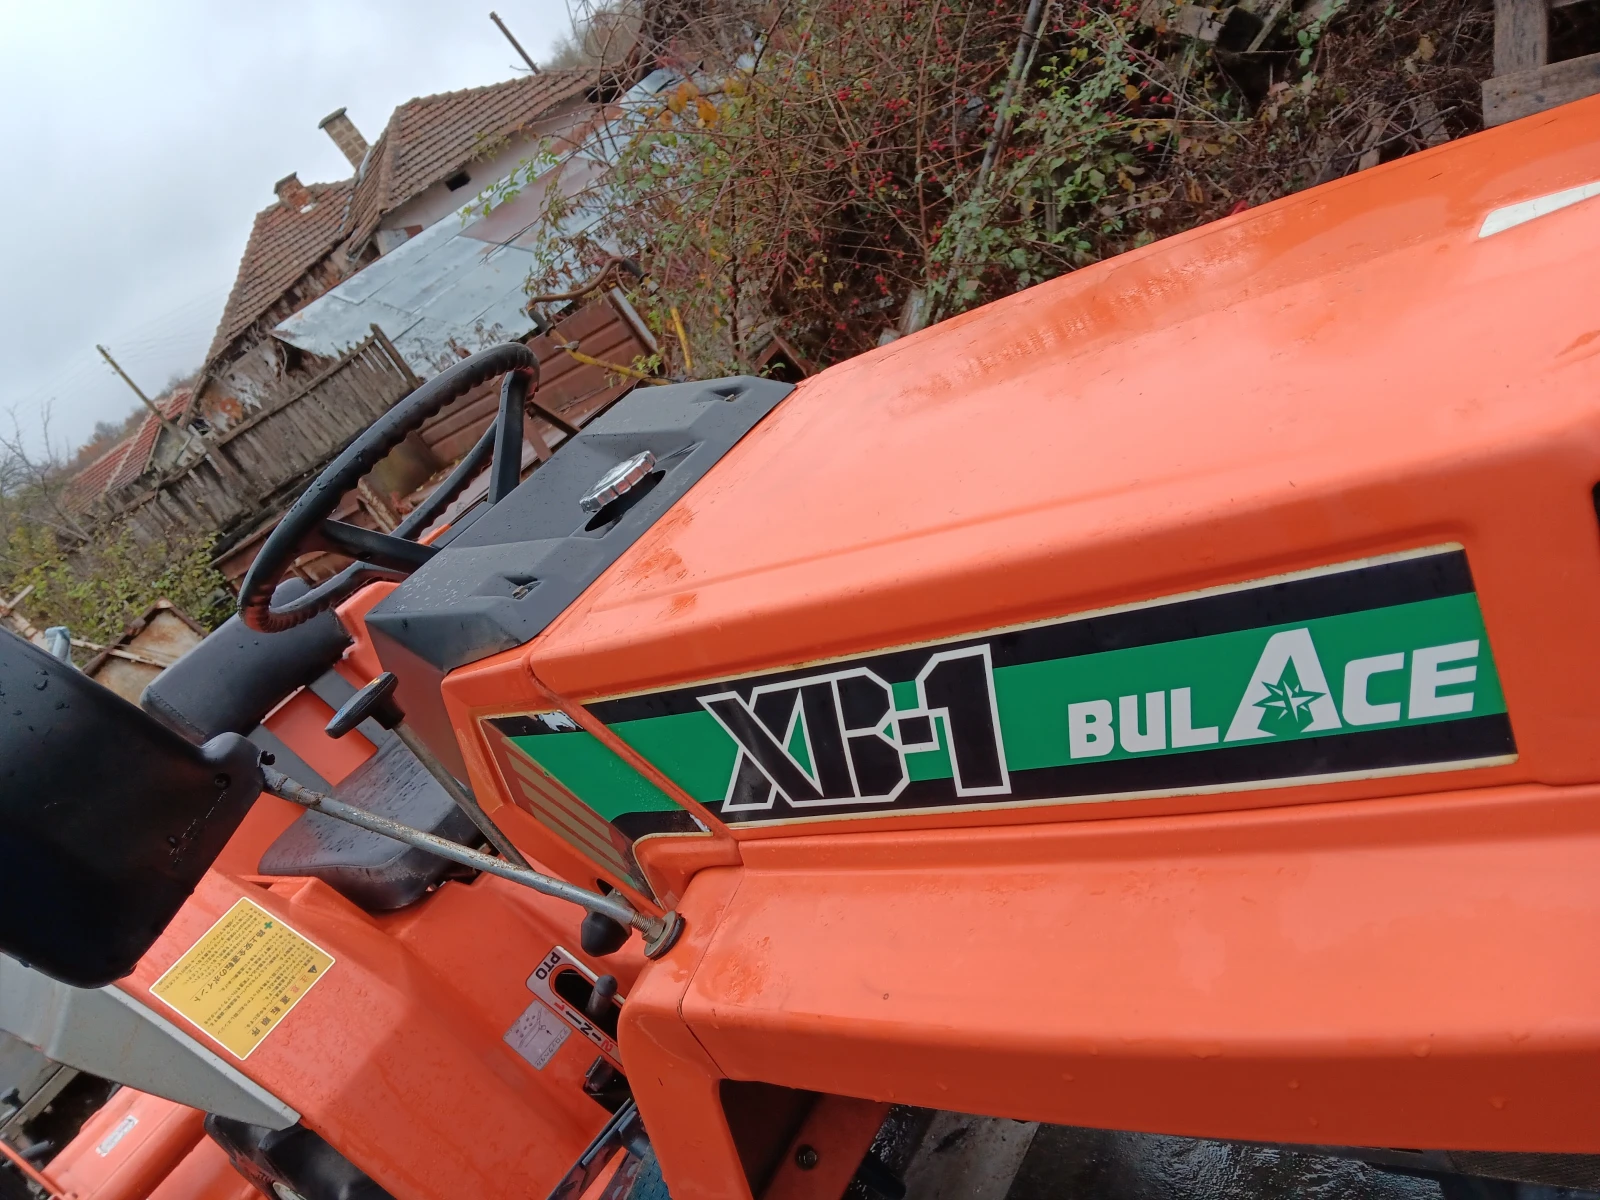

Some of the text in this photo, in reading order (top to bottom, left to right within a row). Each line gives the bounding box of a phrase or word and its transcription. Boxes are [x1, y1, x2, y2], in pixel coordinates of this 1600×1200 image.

[696, 644, 1010, 813] XB-1
[535, 952, 560, 980] PTO
[554, 1002, 564, 1011] 1
[601, 1041, 613, 1052] 2
